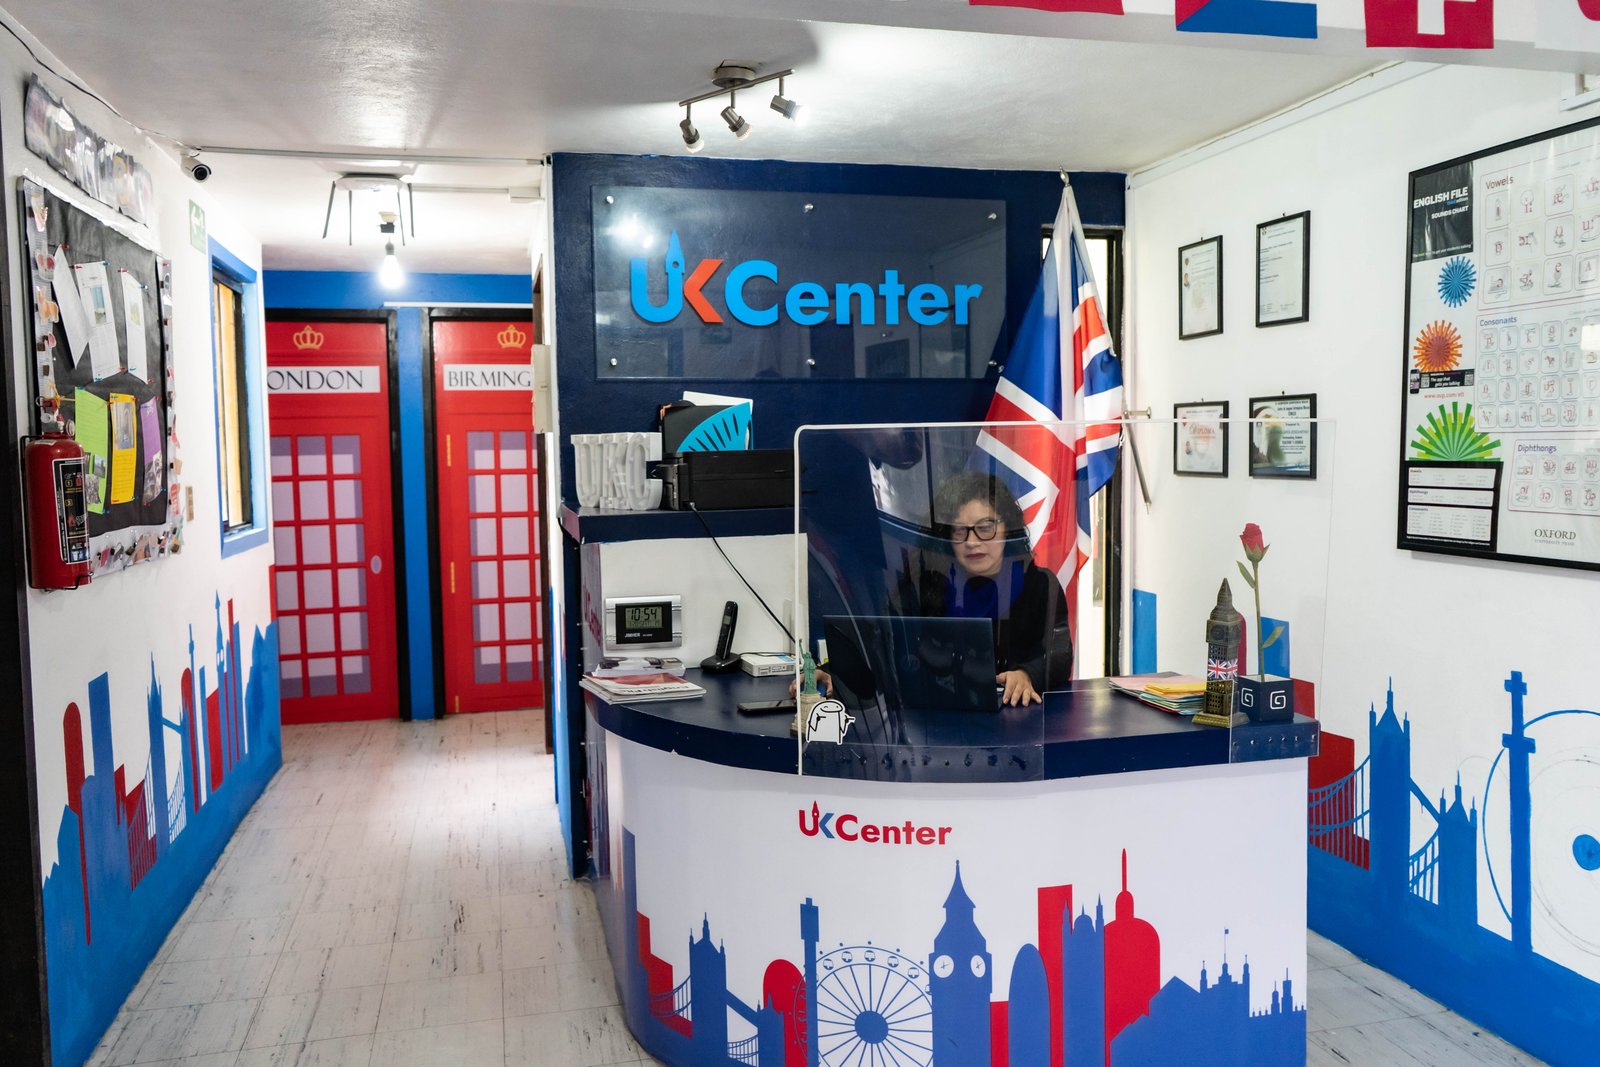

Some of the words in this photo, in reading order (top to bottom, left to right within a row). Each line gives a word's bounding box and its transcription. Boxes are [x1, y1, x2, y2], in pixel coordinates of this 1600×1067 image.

[1486, 176, 1514, 190] Vowels
[1414, 192, 1449, 208] ENGLISH
[1451, 186, 1468, 199] FILE
[1452, 206, 1469, 214] CHART
[630, 229, 983, 326] UKCenter
[1480, 316, 1517, 326] Consonants
[448, 370, 530, 387] BIRMING
[1518, 444, 1557, 454] Diphthongs
[1534, 528, 1576, 540] OXFORD
[631, 608, 657, 620] 10:54
[799, 800, 952, 845] UKCenter
